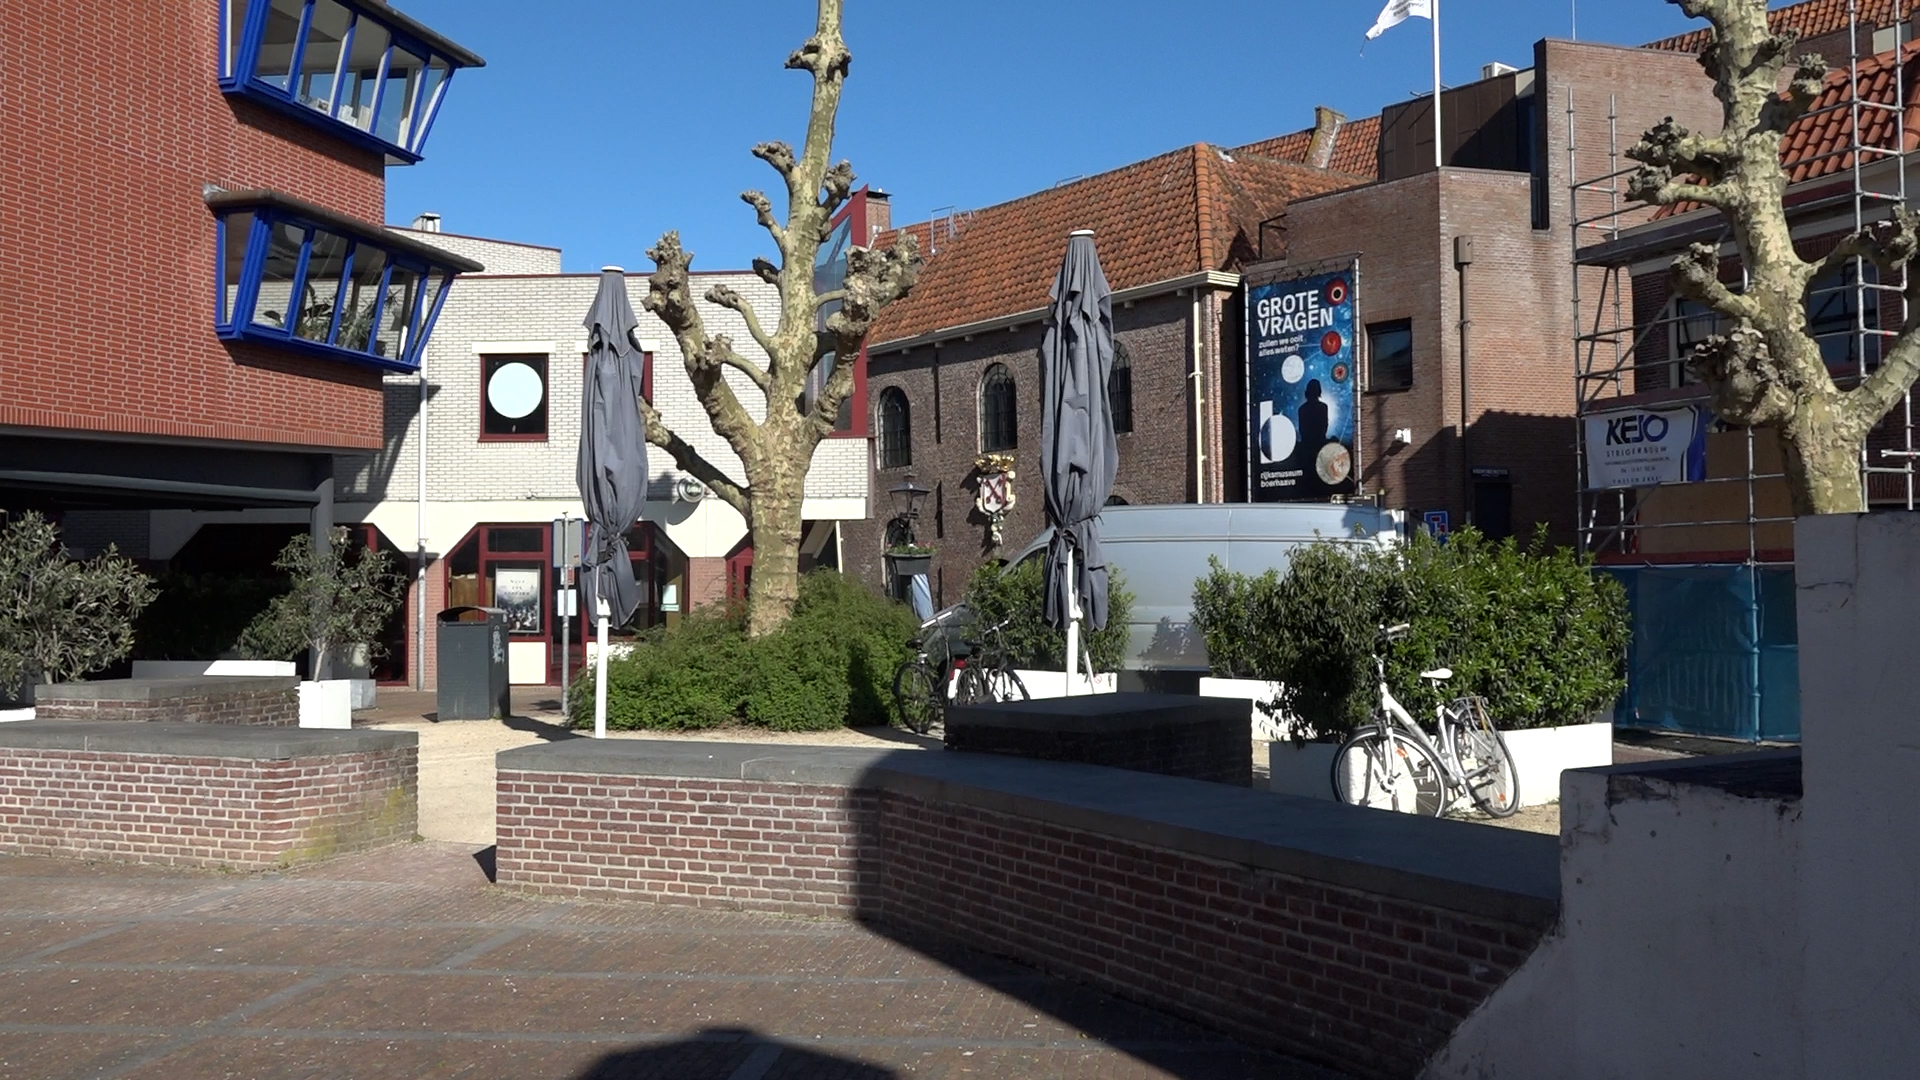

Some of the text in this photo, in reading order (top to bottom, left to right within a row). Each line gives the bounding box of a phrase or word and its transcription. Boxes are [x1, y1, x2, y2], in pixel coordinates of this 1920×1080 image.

[1257, 289, 1319, 318] GROTE
[1257, 307, 1333, 337] VRAGEN
[1279, 338, 1289, 346] we
[1290, 334, 1303, 344] ooit
[1275, 343, 1300, 354] weten?
[1260, 469, 1303, 480] rijksmuseum
[1260, 479, 1296, 488] boerhaave
